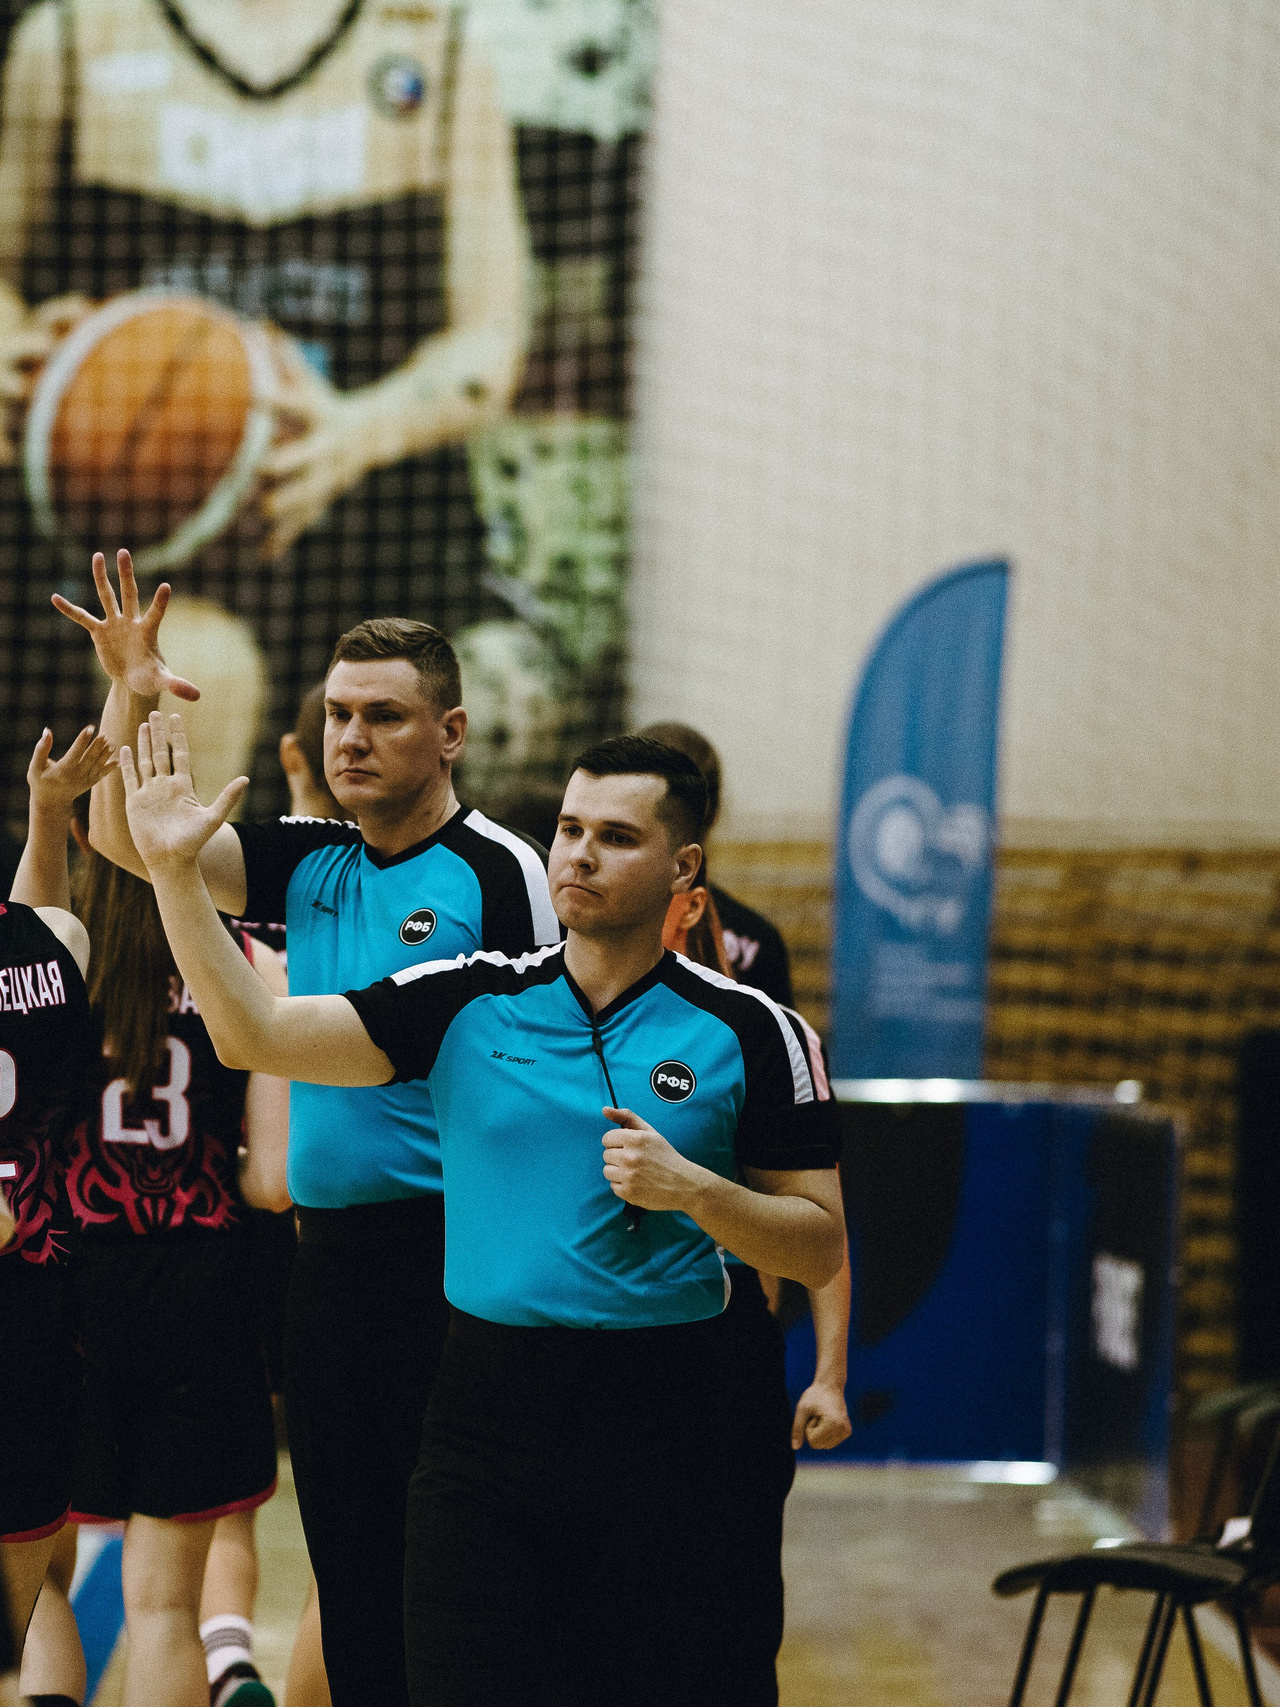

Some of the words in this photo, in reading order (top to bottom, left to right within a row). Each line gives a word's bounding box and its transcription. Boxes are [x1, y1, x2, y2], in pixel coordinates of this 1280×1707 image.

[405, 920, 431, 933] РФБ
[506, 1055, 538, 1066] SPORT
[657, 1073, 690, 1091] РФБ
